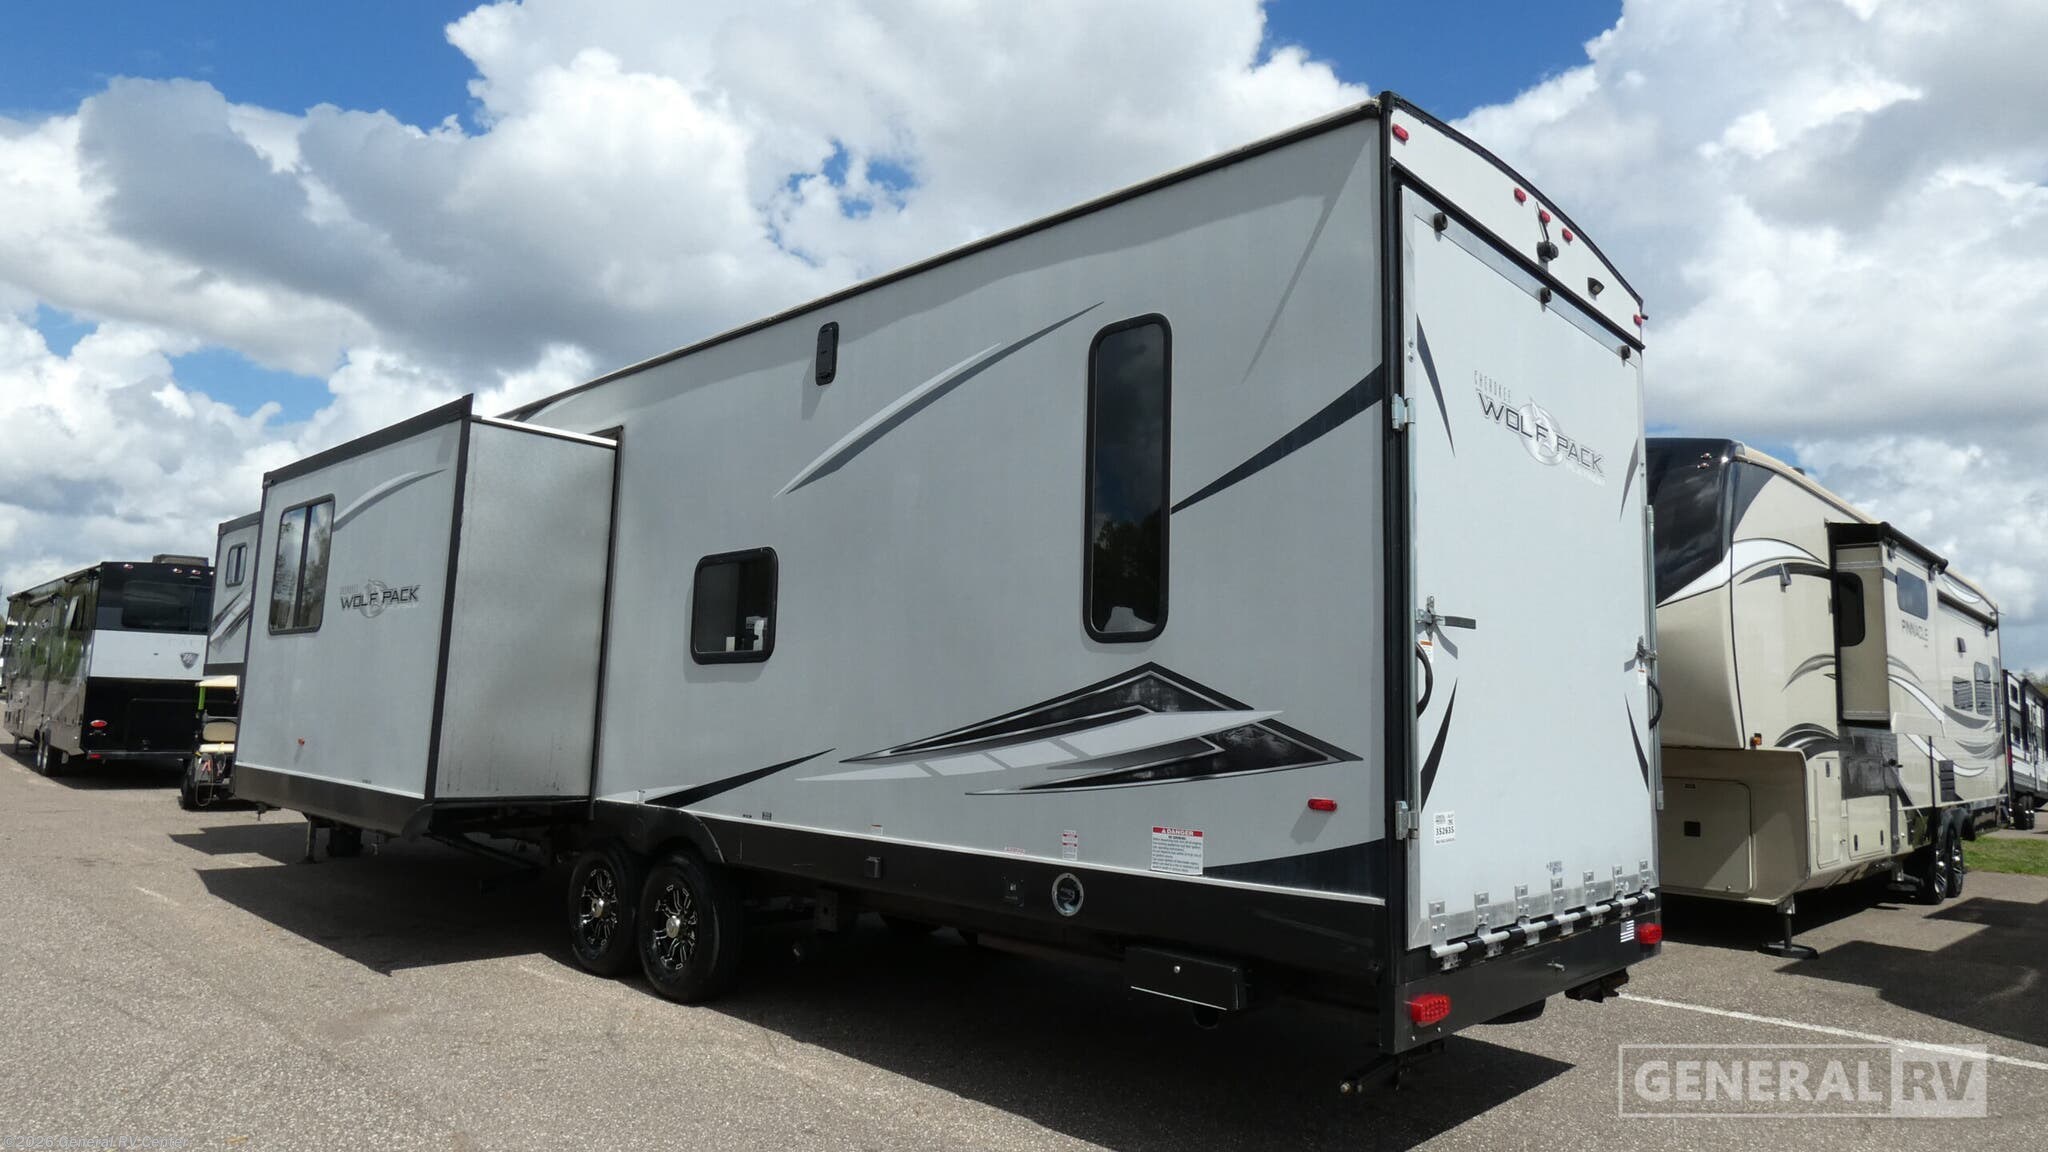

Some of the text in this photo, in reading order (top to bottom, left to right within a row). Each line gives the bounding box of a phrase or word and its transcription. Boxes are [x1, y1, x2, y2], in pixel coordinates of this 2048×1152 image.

[1477, 391, 1549, 441] WOLF
[1555, 433, 1604, 475] PACK
[340, 585, 421, 610] WOLF PACK
[1167, 829, 1193, 837] DANGER
